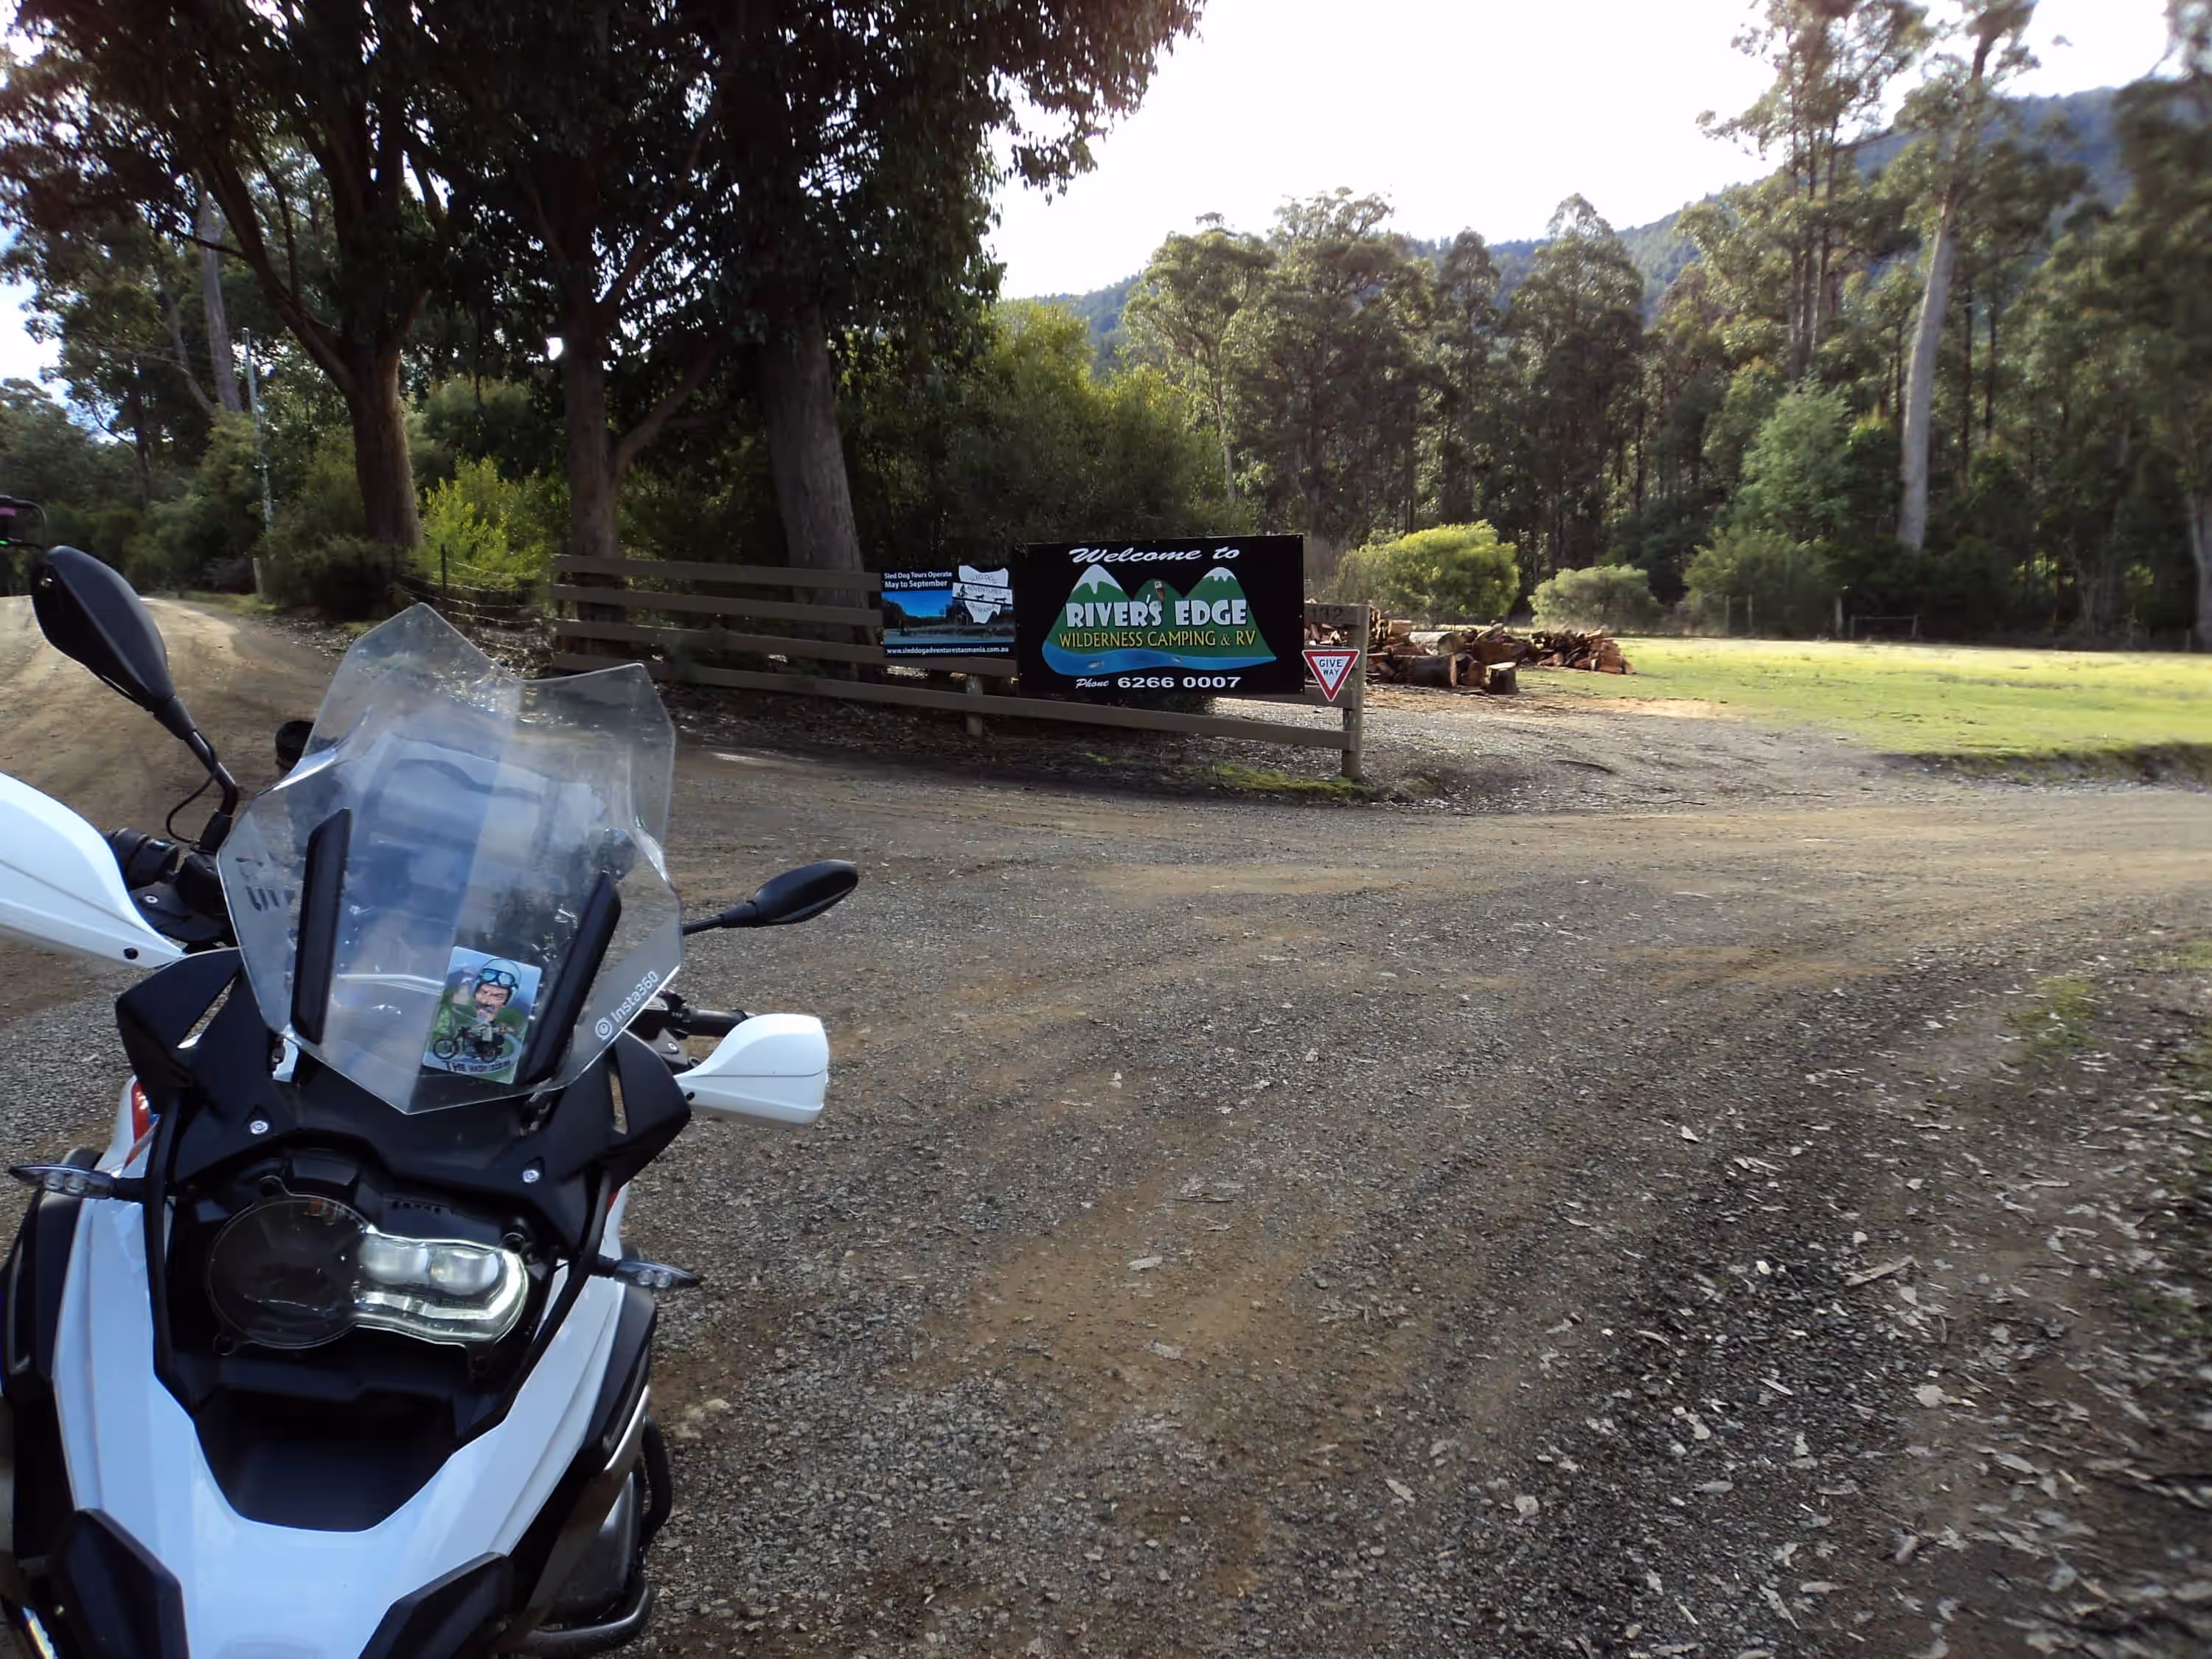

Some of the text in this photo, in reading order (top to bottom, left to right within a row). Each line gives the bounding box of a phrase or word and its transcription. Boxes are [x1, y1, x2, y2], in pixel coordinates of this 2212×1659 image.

[1069, 546, 1240, 563] Welcome to
[885, 581, 899, 589] May
[909, 580, 947, 588] September
[1065, 594, 1247, 627] RIVER'S EDGE
[1059, 630, 1256, 647] WILDERNESS CAMPING & RV
[887, 646, 1009, 655] www.sleddogadventurestasmania.com.au
[1319, 659, 1343, 667] GIVE
[1076, 676, 1242, 689] Phone 6266 0007
[611, 970, 658, 1023] Insta360
